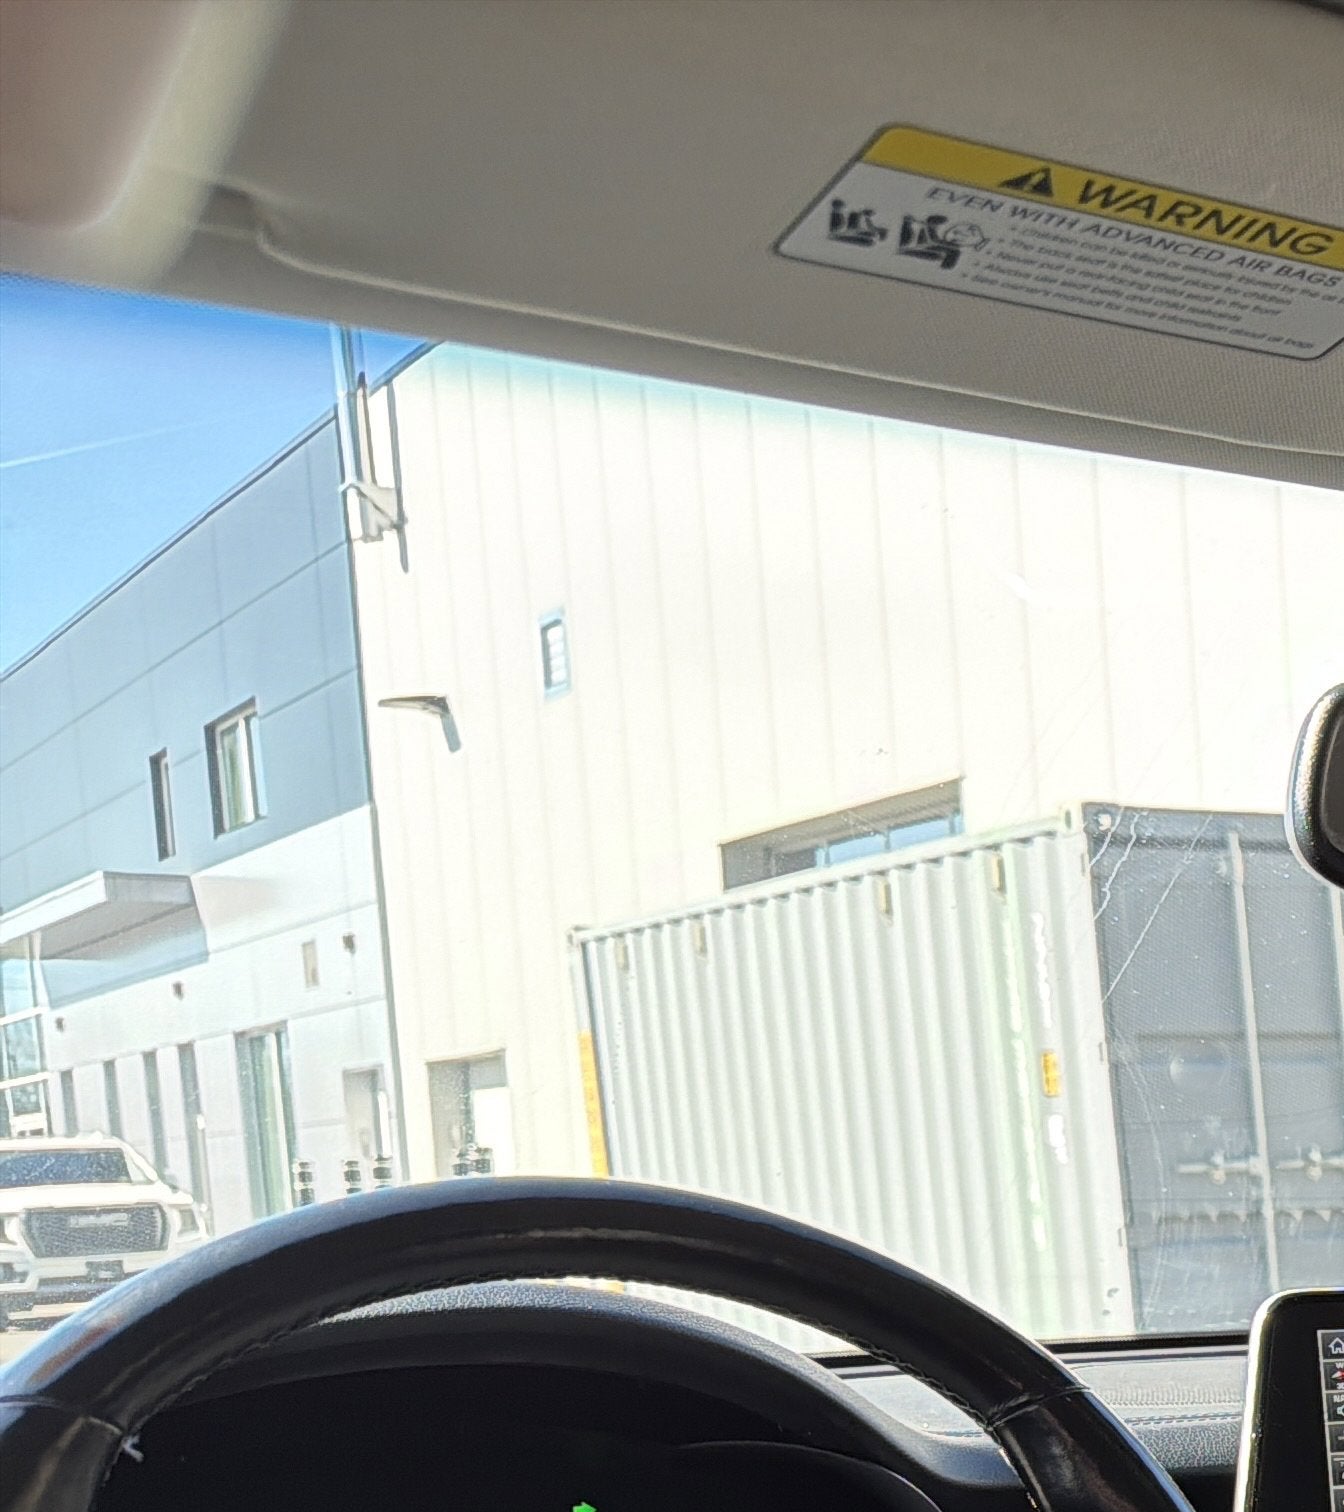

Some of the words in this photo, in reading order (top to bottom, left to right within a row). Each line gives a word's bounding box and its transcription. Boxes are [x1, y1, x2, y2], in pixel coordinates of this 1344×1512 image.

[928, 186, 1004, 213] EVEN
[1009, 204, 1079, 230] WITH
[1082, 221, 1227, 263] ADVANCED
[1229, 254, 1272, 273] AIR
[1275, 264, 1342, 288] BAGS
[1077, 178, 1335, 258] WARNING
